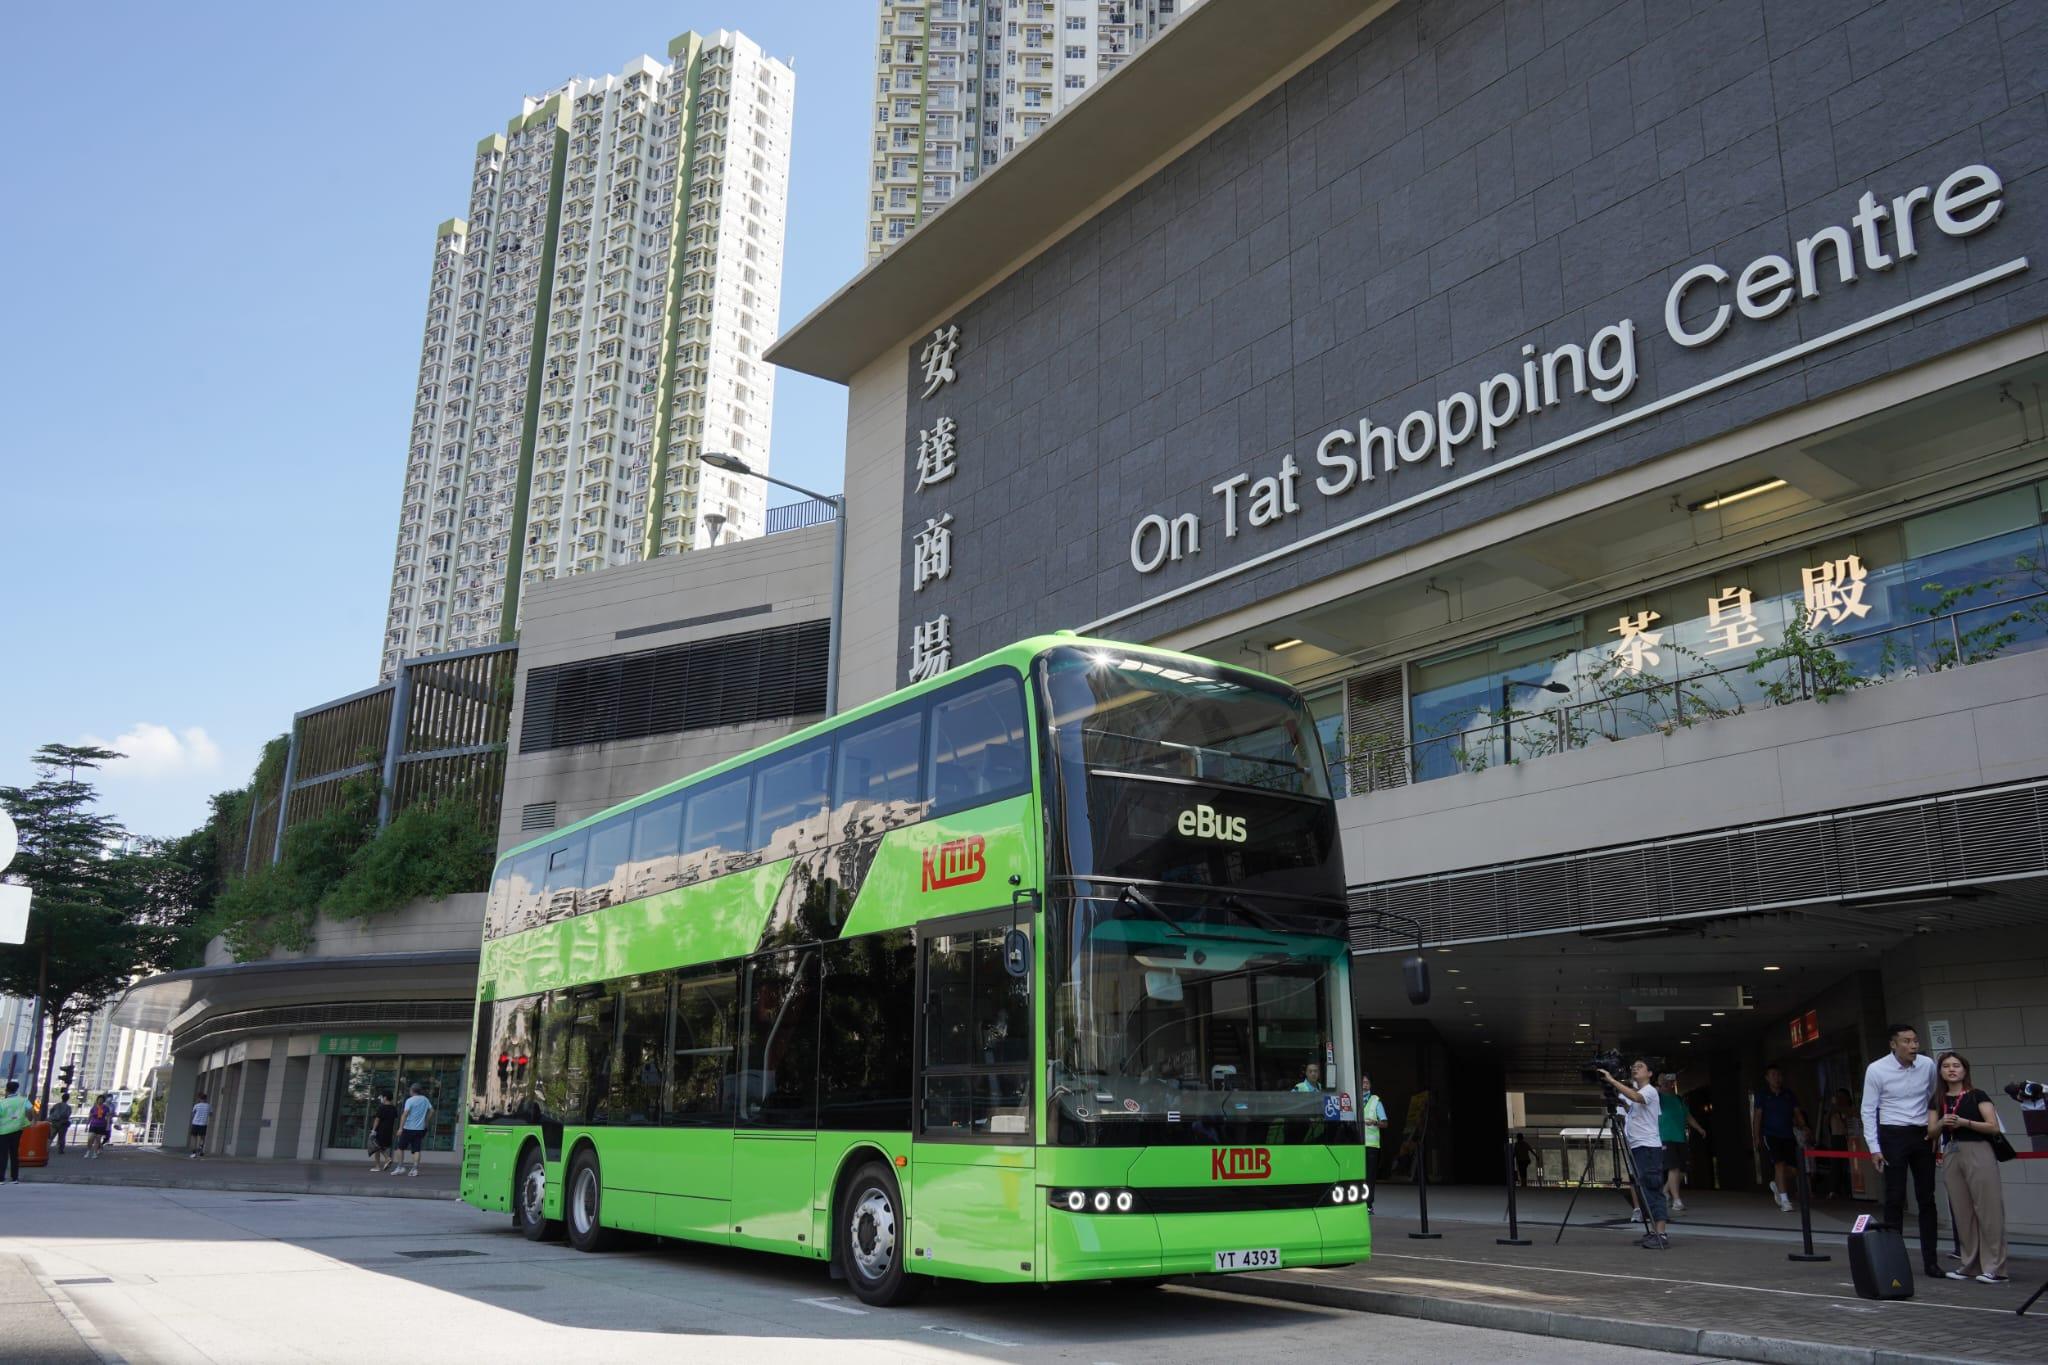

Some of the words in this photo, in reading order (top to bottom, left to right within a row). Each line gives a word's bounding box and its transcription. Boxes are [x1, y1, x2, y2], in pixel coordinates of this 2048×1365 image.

[1131, 511, 1200, 573] On
[1212, 454, 1300, 537] Tat
[1315, 318, 1638, 497] Shopping
[1664, 164, 2004, 347] Centre
[909, 324, 961, 684] 安達商場
[1607, 554, 1872, 678] 茶皇殿
[1177, 804, 1247, 843] eBus
[922, 835, 986, 893] KMB
[1211, 1148, 1272, 1180] KMB
[1218, 1252, 1236, 1268] YT
[1243, 1250, 1277, 1266] 4393
